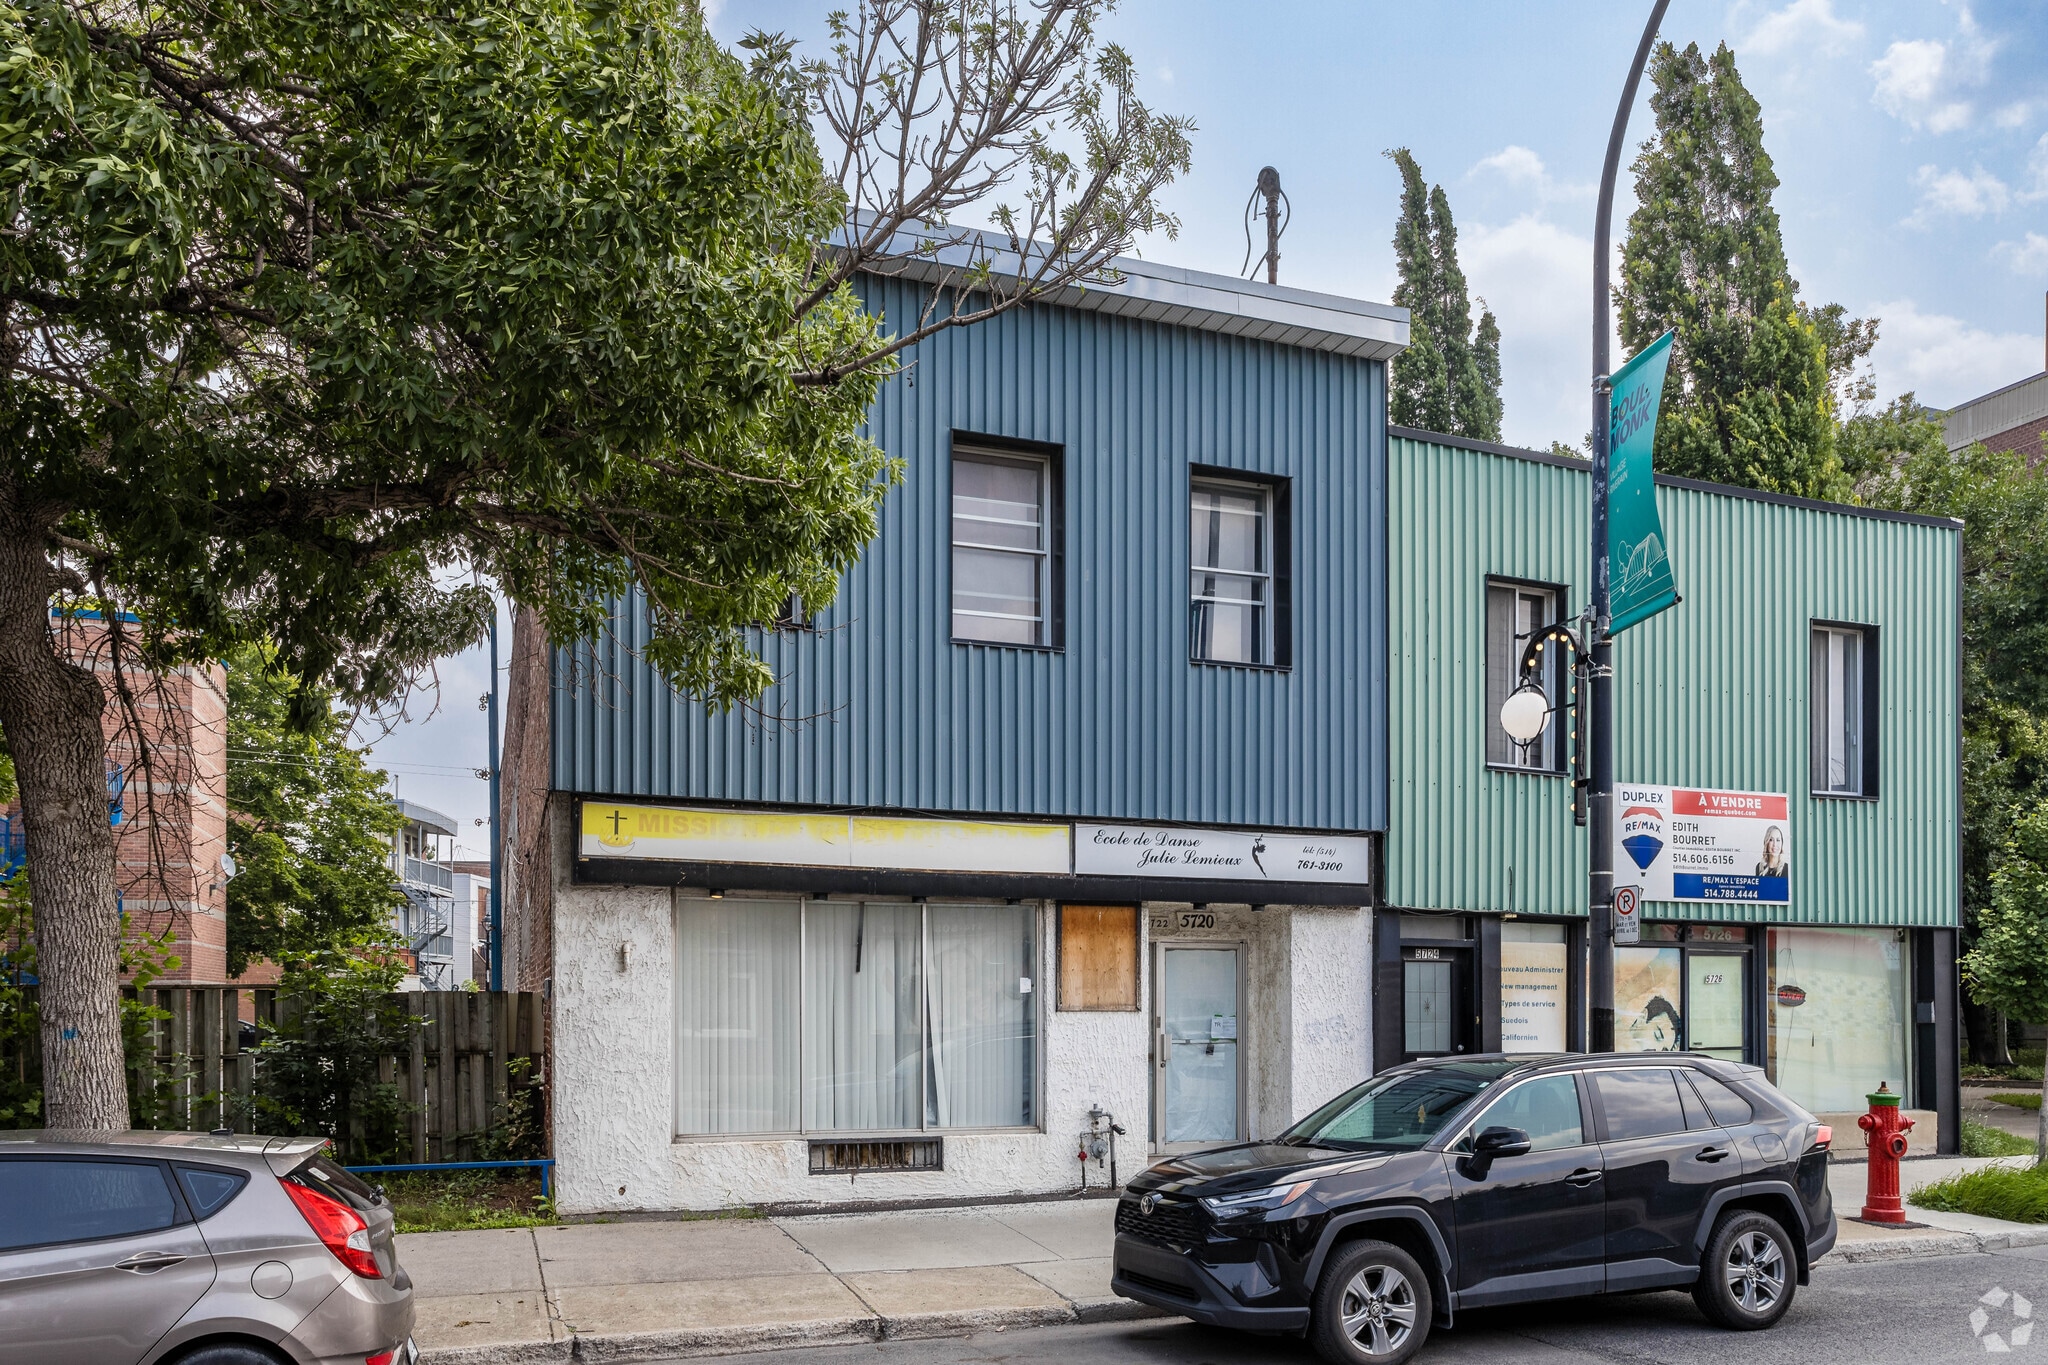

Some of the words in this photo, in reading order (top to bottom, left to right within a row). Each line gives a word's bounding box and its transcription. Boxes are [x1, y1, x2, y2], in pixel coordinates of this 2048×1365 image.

[1610, 398, 1652, 457] MONK
[1622, 791, 1664, 804] DUPLEX
[1698, 792, 1708, 806] À
[1711, 795, 1762, 809] VENDRE
[1704, 808, 1757, 816] remax-quebec.com
[1625, 820, 1661, 834] RE/MAX
[1672, 822, 1699, 832] EDITH
[1133, 832, 1151, 846] de
[1155, 831, 1203, 847] Danse
[1672, 835, 1716, 846] BOURRET
[1316, 846, 1337, 857] (514)
[1137, 848, 1178, 868] Julie
[1181, 849, 1243, 866] Lemieux
[1672, 853, 1734, 865] 514.606.6156
[1297, 860, 1343, 871] 761-3100
[1702, 876, 1729, 884] RE/MAX
[1730, 877, 1760, 886] L'ESPACE
[1704, 889, 1758, 899] 514.788.4444
[1180, 914, 1215, 929] 5720
[1703, 930, 1732, 941] 5726
[1705, 974, 1723, 983] 5726
[1779, 991, 1804, 1000] OUVERT
[1501, 1000, 1520, 1008] Types
